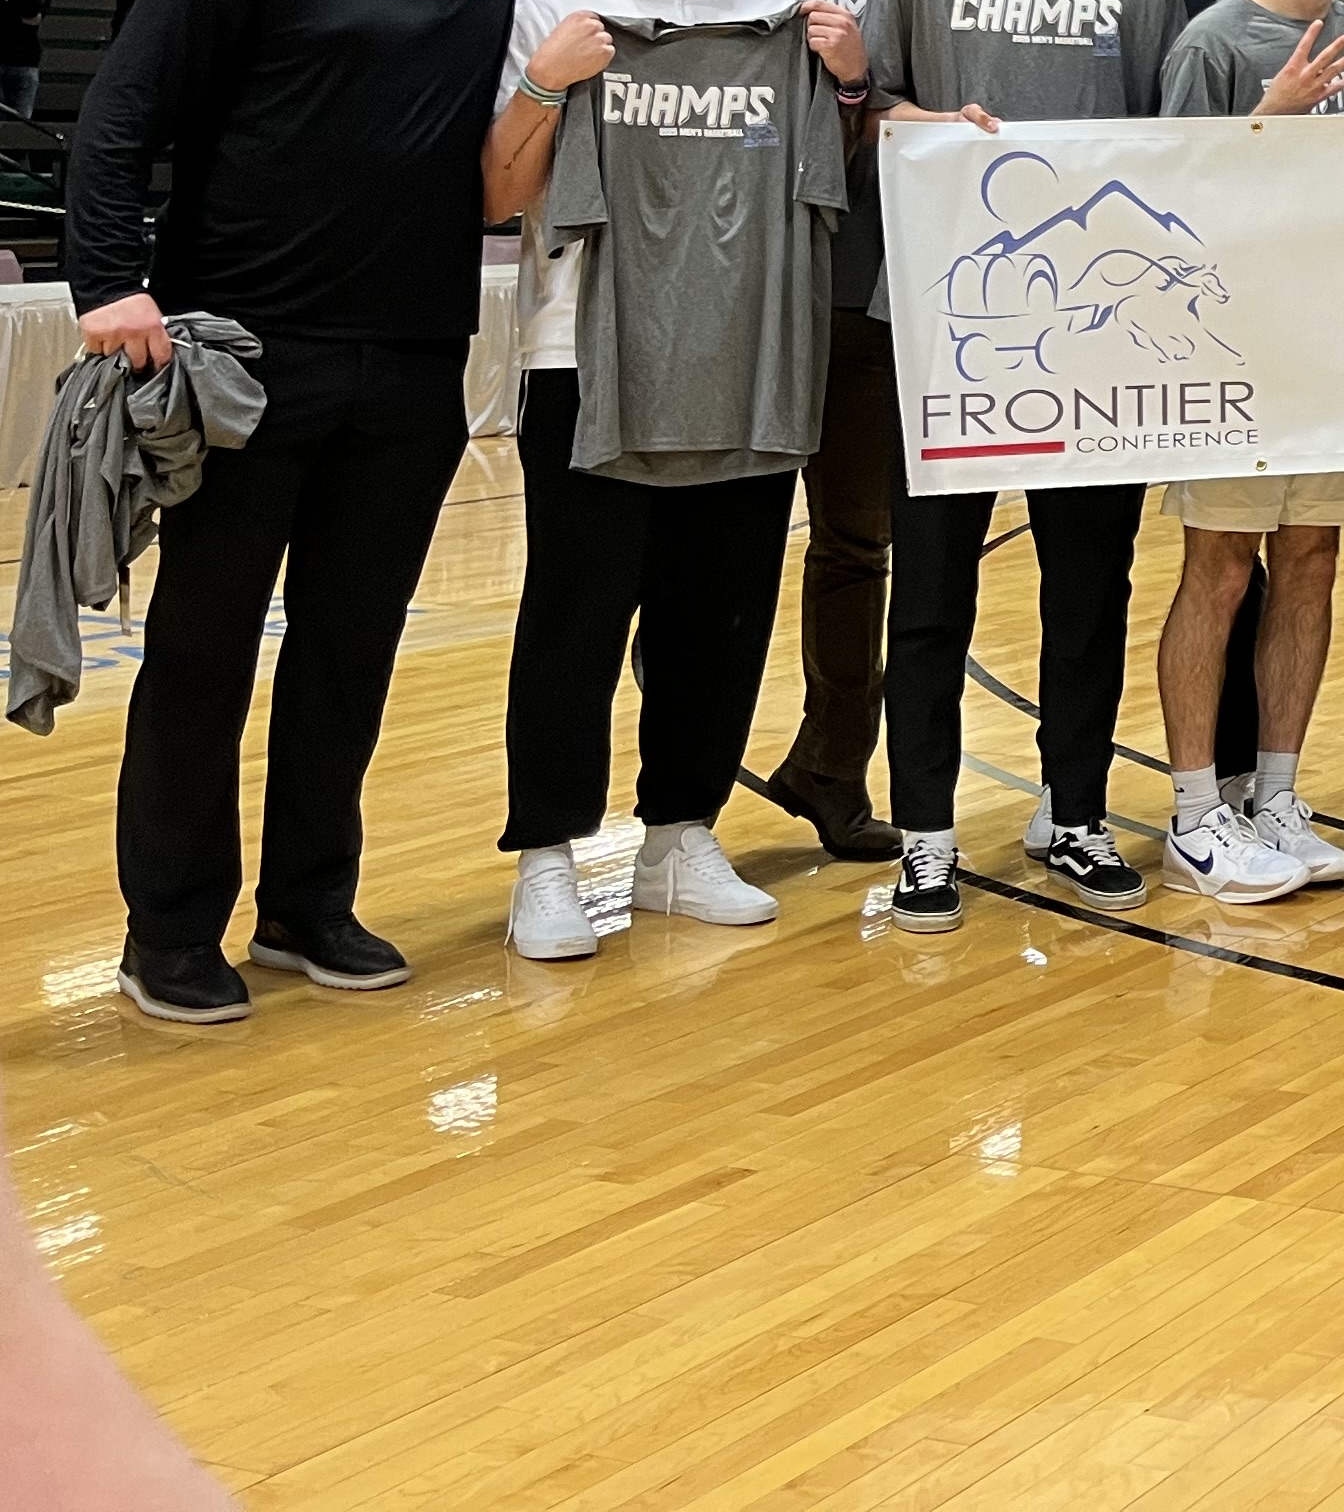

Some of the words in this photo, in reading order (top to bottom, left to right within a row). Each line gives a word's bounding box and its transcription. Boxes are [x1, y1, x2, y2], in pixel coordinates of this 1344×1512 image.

[603, 80, 774, 128] CHAMPS
[922, 381, 1256, 439] FRONTIER
[1076, 429, 1259, 454] CONFERENCE
